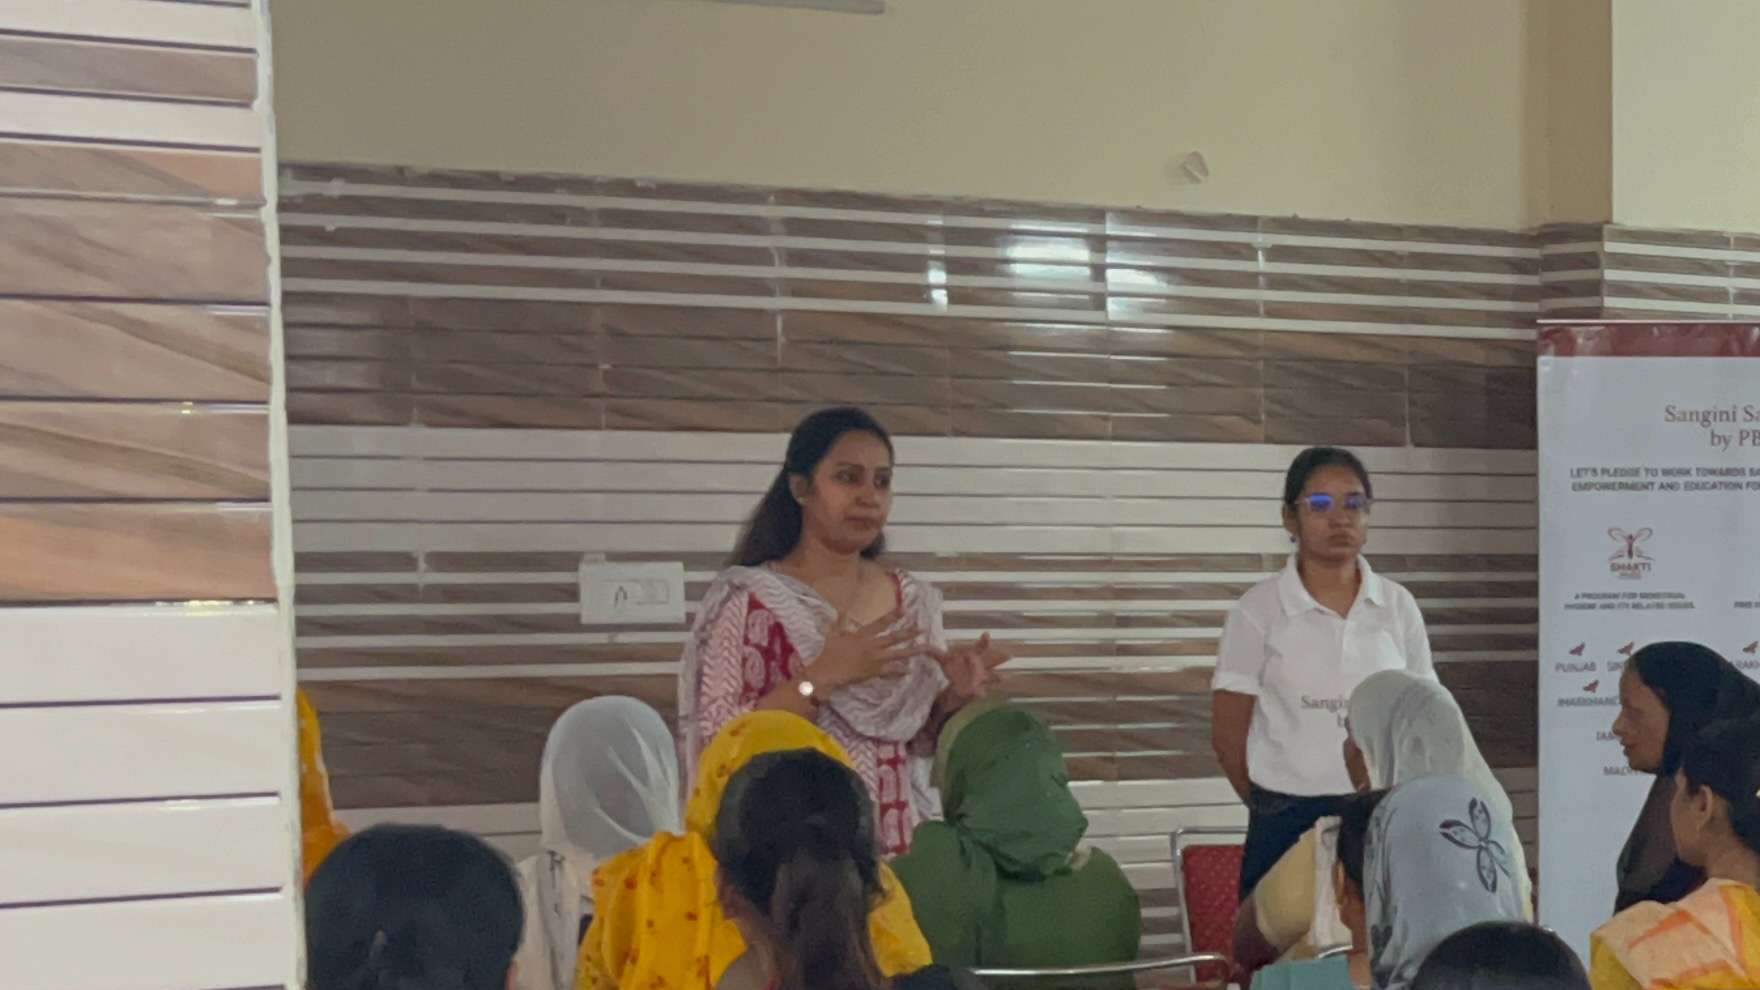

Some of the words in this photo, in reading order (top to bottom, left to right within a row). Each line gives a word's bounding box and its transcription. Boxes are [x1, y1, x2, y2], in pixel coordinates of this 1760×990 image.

[1664, 404, 1737, 428] Sangini
[1710, 429, 1732, 452] by
[1570, 466, 1598, 479] LET'S
[1601, 466, 1640, 479] PLEDGE
[1644, 466, 1658, 479] TO
[1661, 466, 1692, 479] WORK
[1696, 466, 1746, 479] TOWARDS
[1571, 481, 1654, 492] EMPOWERMENT
[1658, 481, 1680, 492] AND
[1684, 481, 1743, 492] EDUCATION
[1555, 661, 1596, 672] PUNJAB
